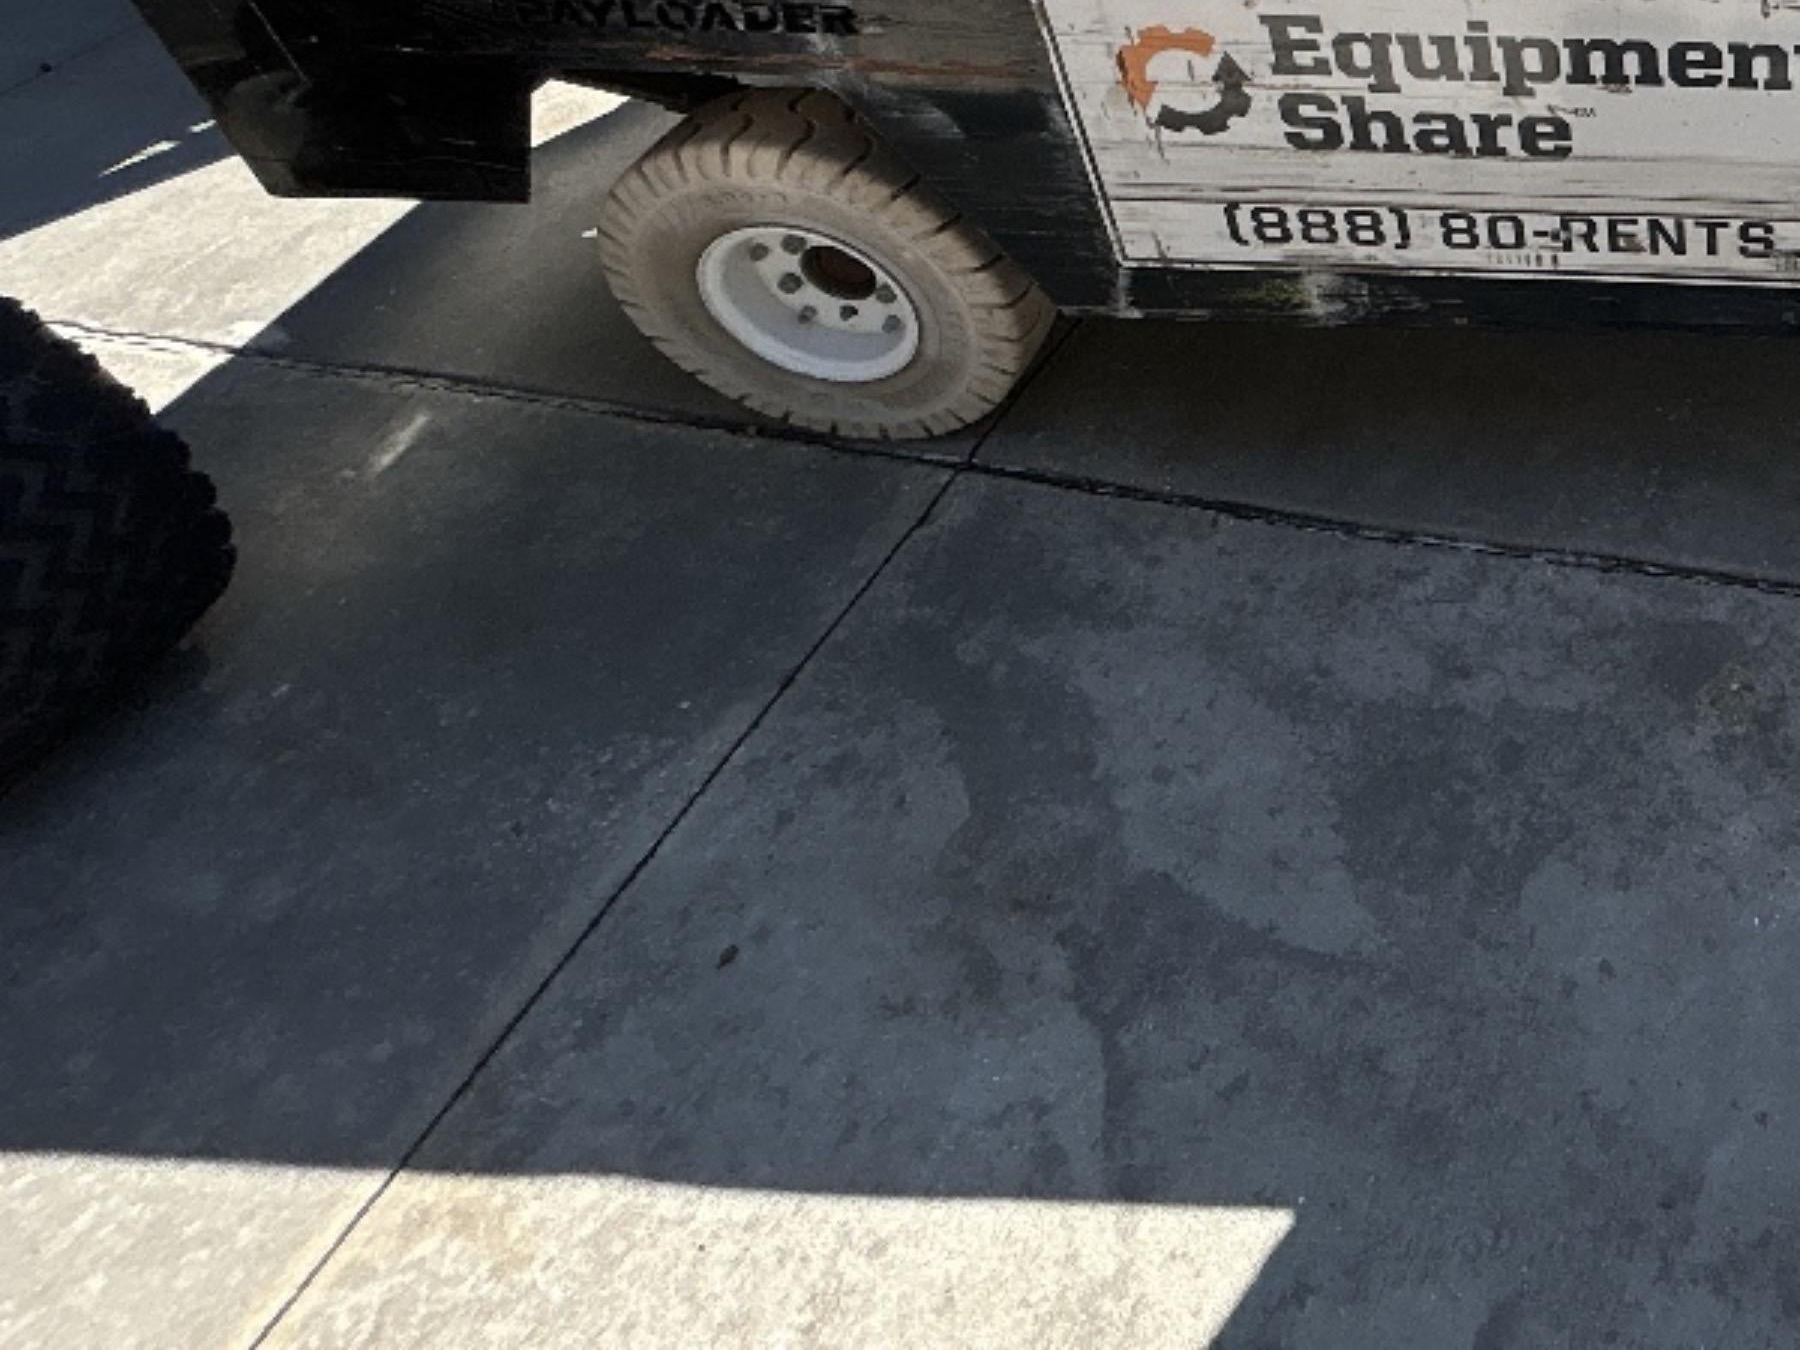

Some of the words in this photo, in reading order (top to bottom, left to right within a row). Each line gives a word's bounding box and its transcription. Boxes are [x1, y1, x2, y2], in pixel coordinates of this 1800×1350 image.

[1277, 92, 1574, 159] Share
[1223, 201, 1411, 250] (888)
[1439, 211, 1775, 258] 80-RENTS
